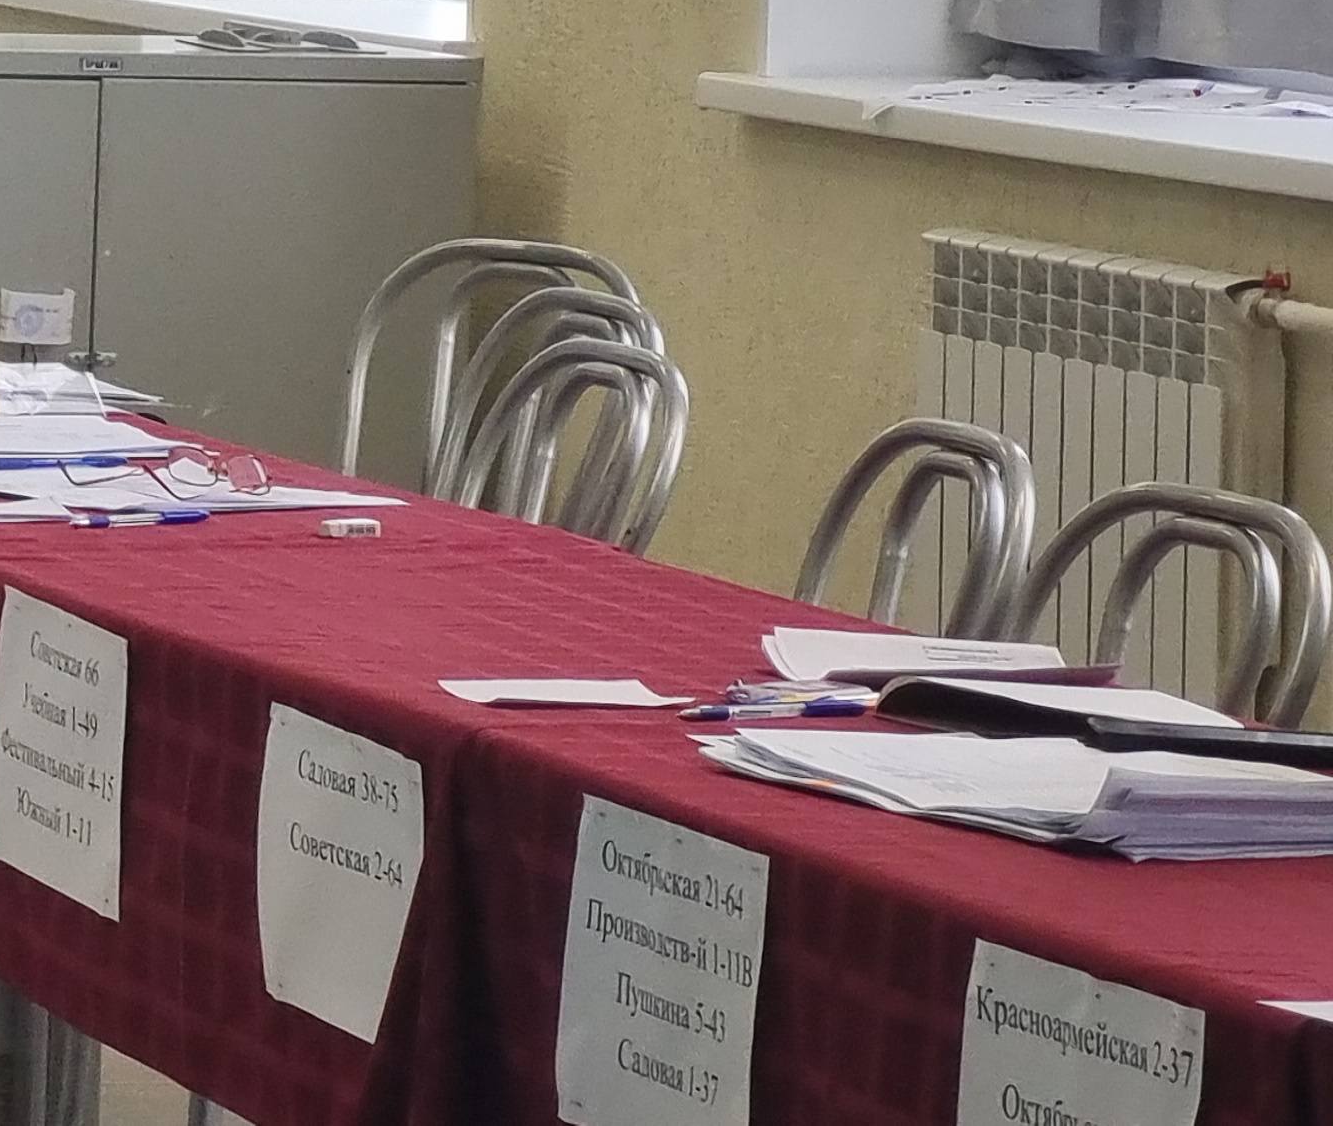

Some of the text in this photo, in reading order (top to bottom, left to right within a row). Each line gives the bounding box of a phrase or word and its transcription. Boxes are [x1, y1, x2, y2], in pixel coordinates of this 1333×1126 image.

[30, 630, 100, 687] Советская 66
[88, 768, 114, 803] 4-15
[298, 749, 399, 814] Садовая 38-75
[17, 786, 92, 847] Южный 1-11
[289, 821, 403, 889] Советская 2-64
[601, 840, 744, 920] Октябрьская 21-64
[585, 898, 707, 972] Производств-й
[616, 972, 726, 1043] Пушкина 5-43
[976, 984, 1194, 1087] Красноармейская 2-37
[618, 1038, 719, 1106] Садовая 1-37
